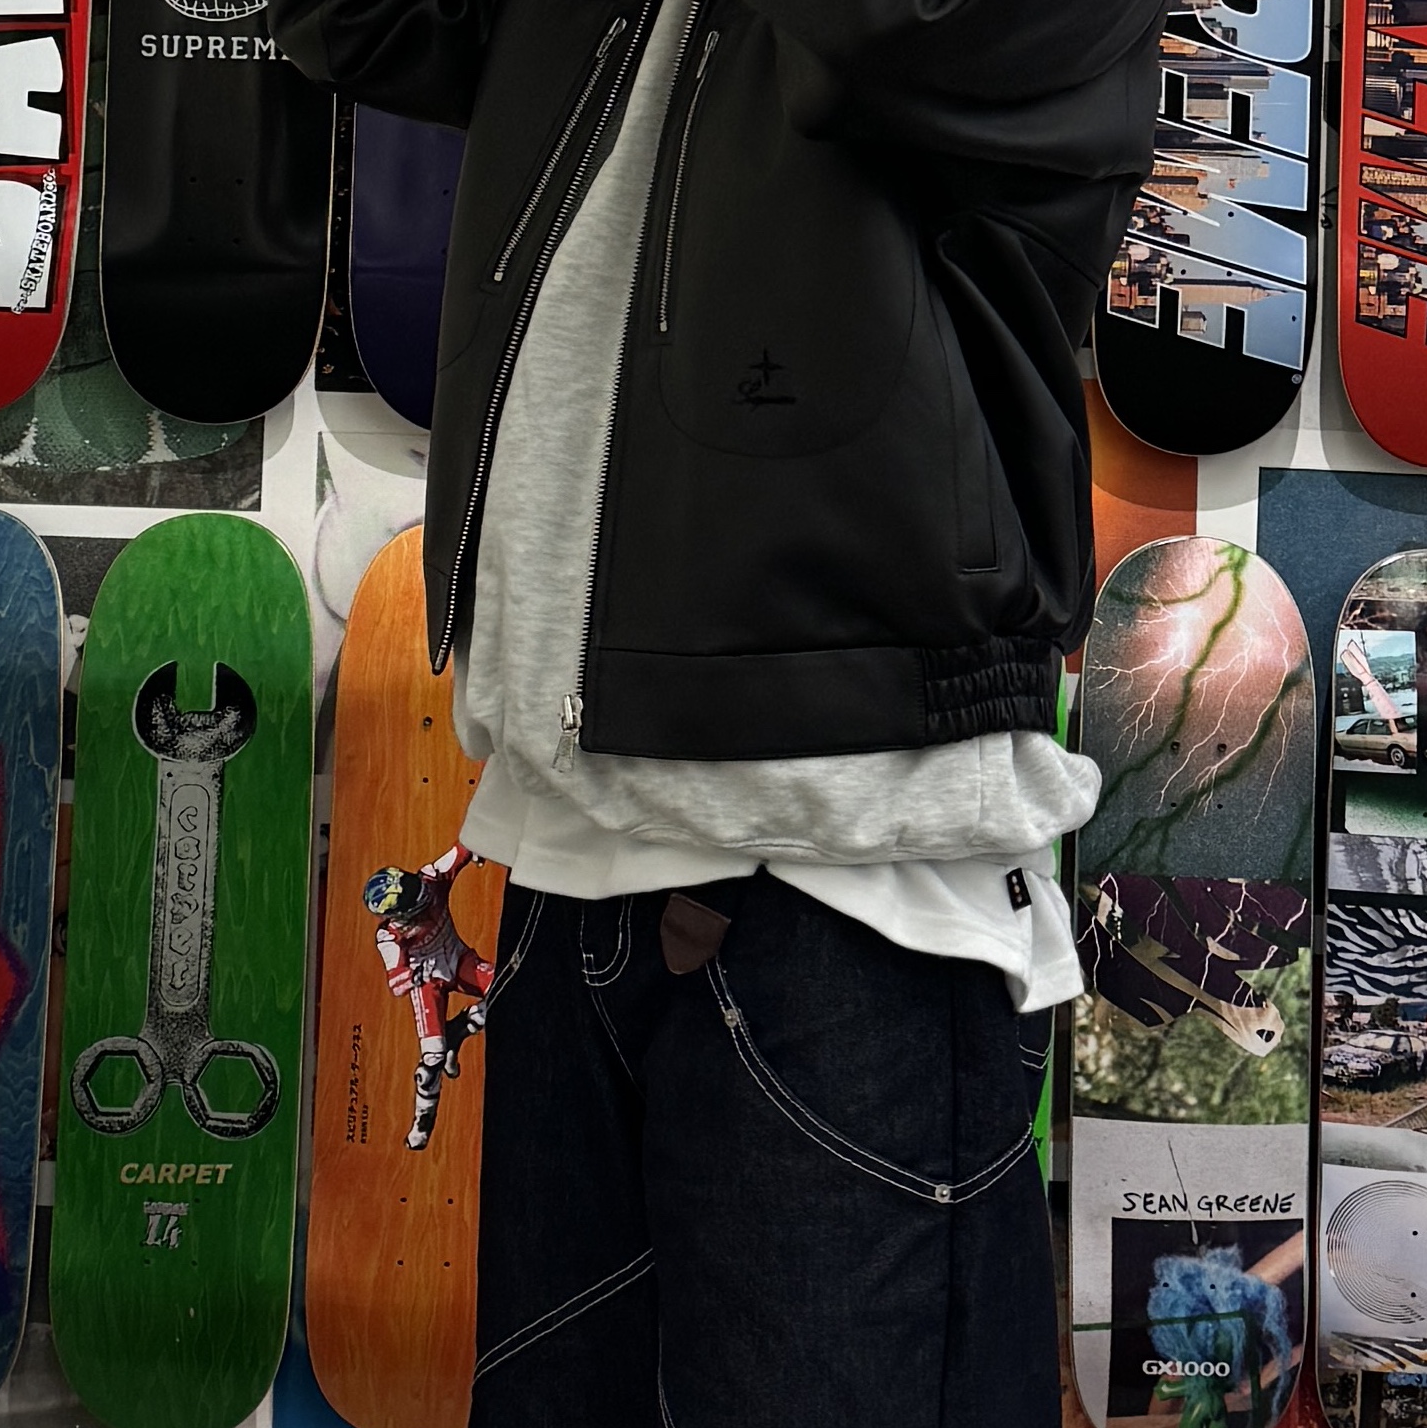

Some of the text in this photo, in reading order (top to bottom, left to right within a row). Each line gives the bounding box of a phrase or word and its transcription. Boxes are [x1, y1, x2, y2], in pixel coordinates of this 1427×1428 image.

[140, 34, 290, 61] SUPREM
[19, 191, 57, 292] SKATEBOARD
[119, 1162, 234, 1185] CARPET
[1121, 1192, 1296, 1219] SEAN GREENE
[1141, 1359, 1231, 1377] GX1000
